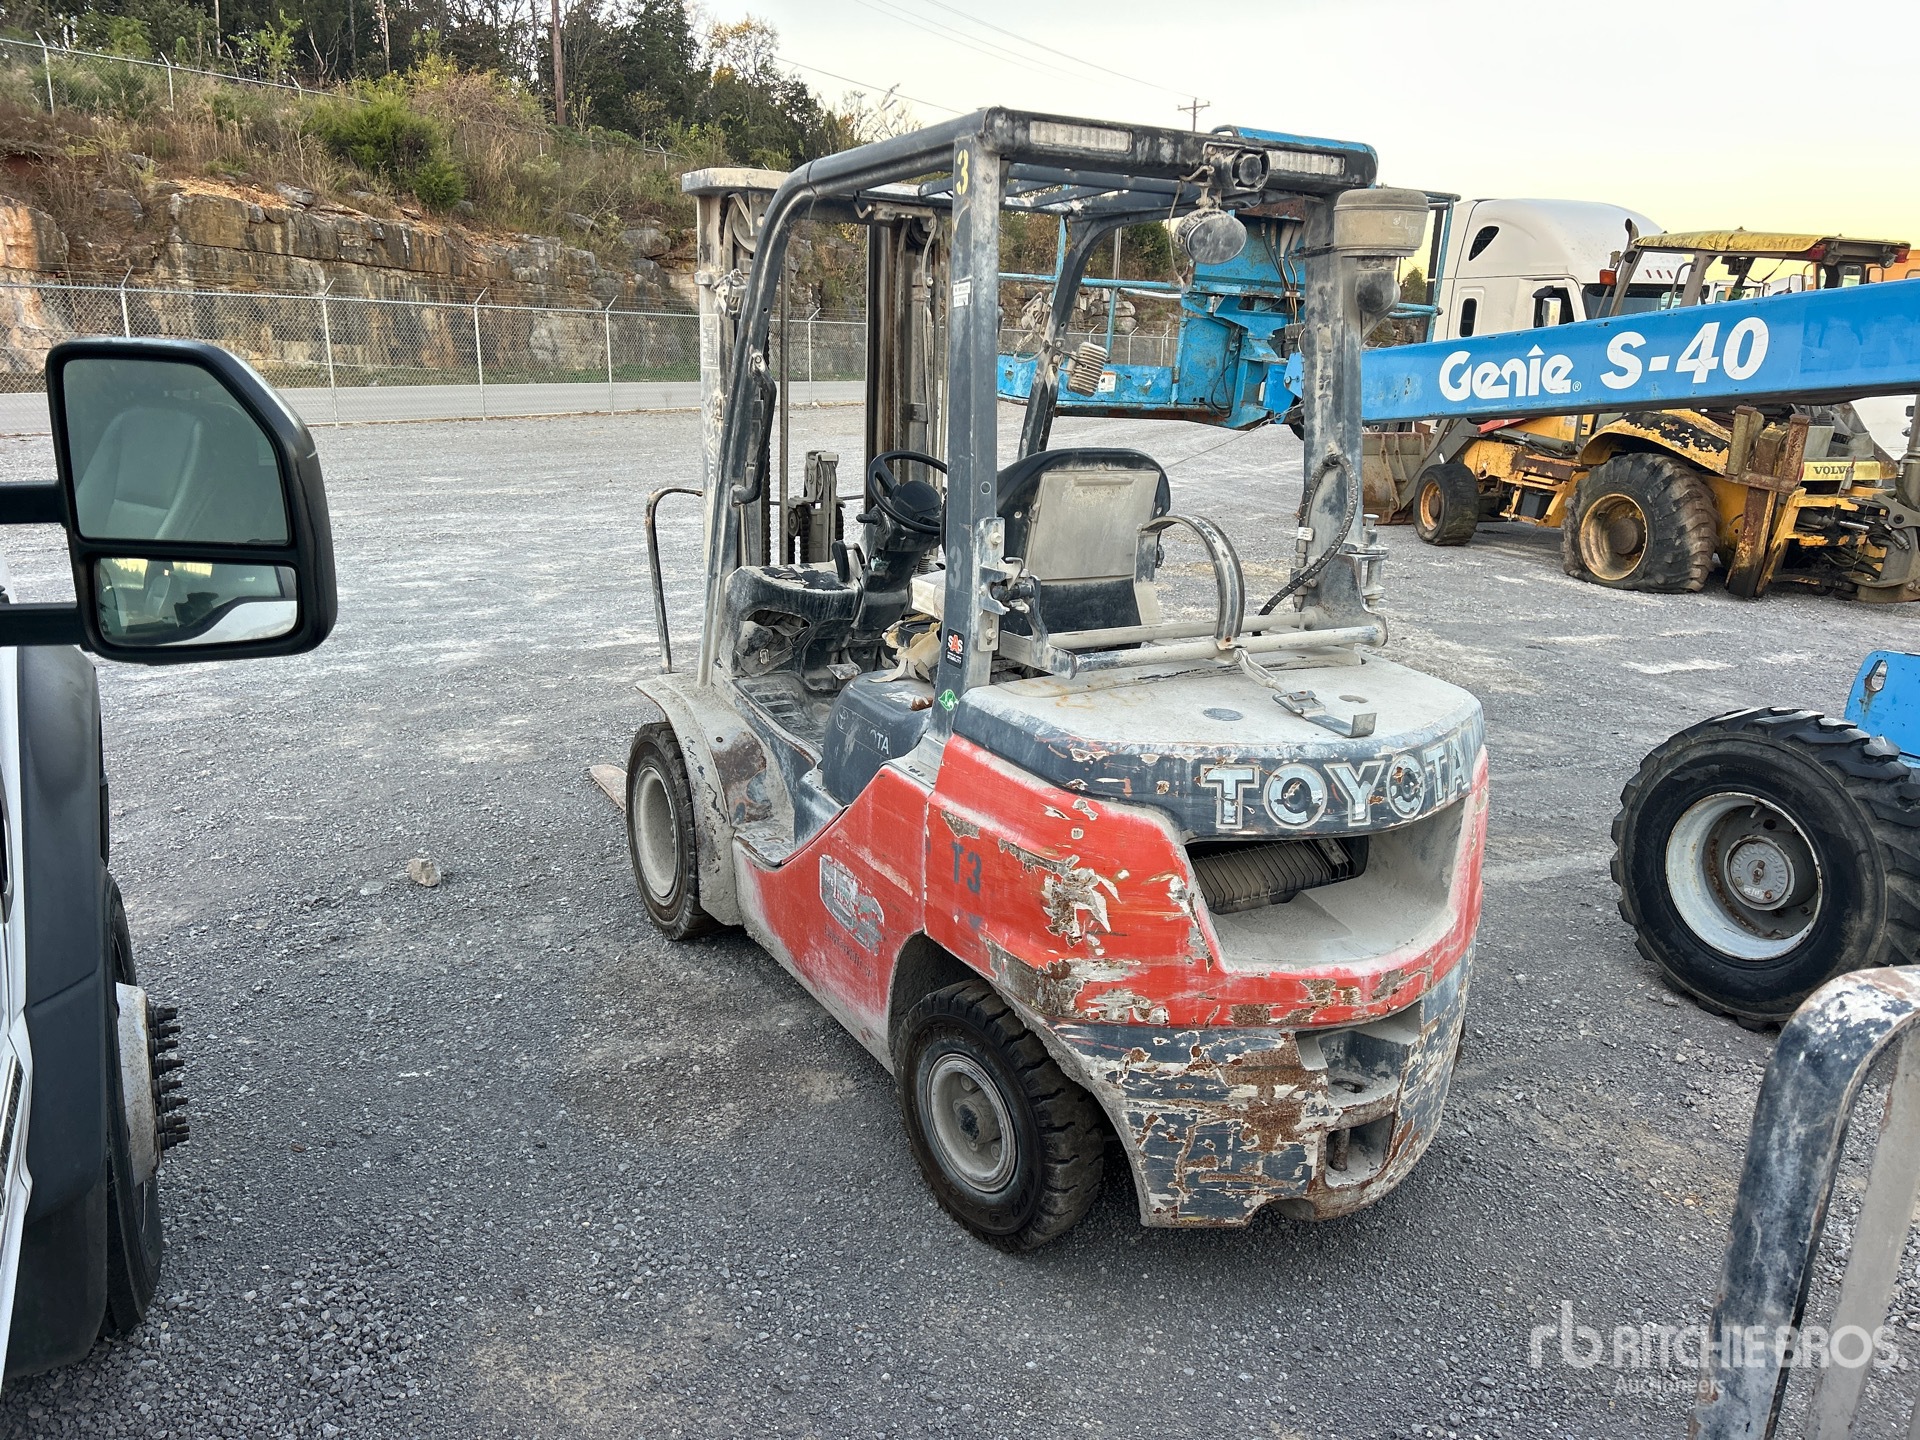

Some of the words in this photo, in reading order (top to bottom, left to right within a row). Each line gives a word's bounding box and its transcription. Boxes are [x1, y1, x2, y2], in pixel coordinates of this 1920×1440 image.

[955, 148, 970, 195] 3
[1438, 343, 1575, 402] Genie
[1600, 316, 1770, 390] S-40
[947, 634, 964, 654] SAS
[1200, 733, 1470, 830] TOYOTA
